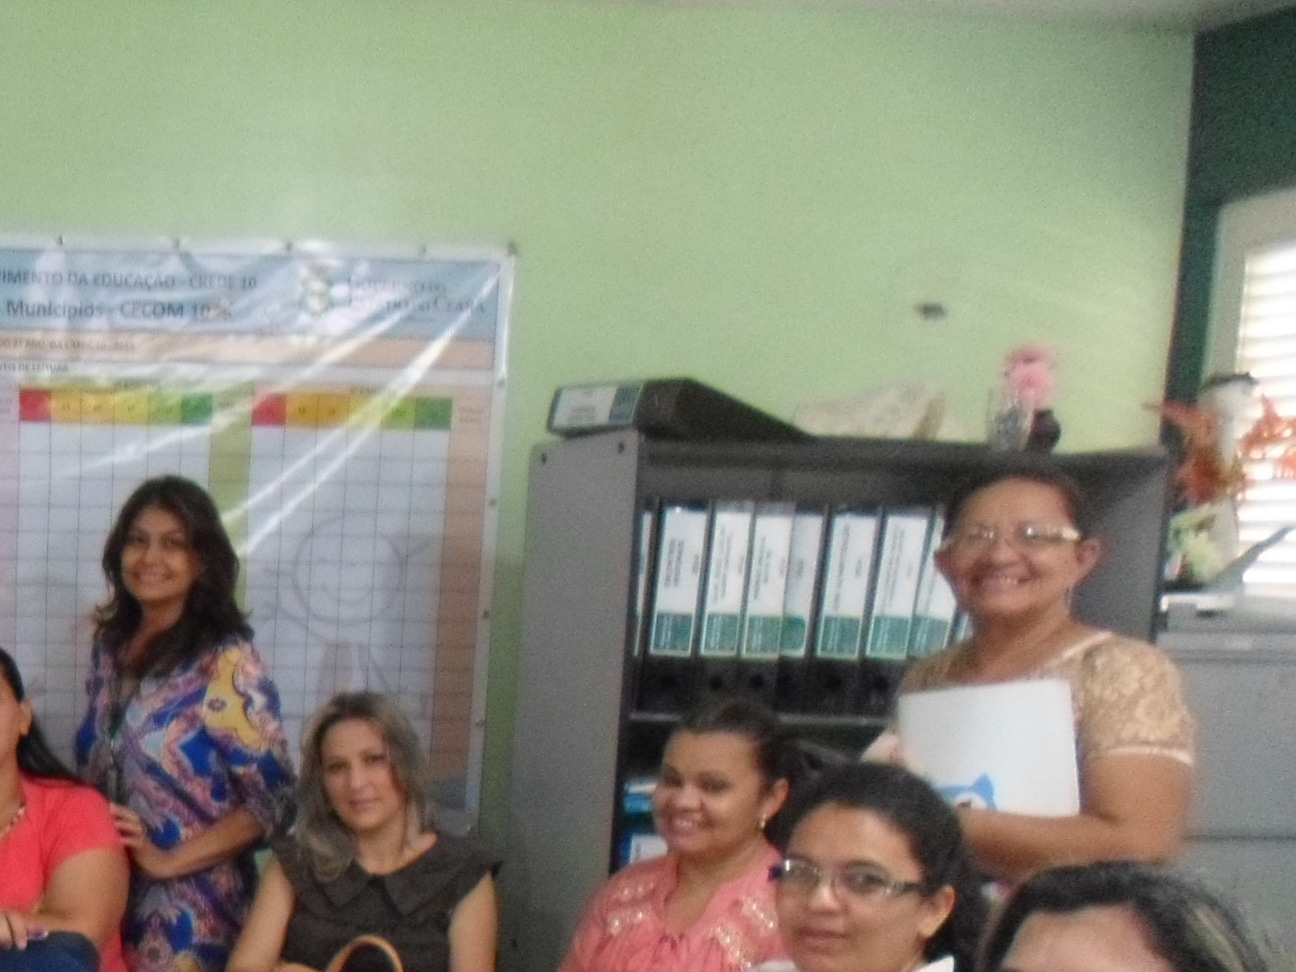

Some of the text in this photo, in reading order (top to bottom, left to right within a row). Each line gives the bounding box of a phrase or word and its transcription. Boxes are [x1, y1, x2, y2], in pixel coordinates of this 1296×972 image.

[68, 272, 88, 287] DA
[93, 270, 176, 291] EDUCAÇÃO
[242, 276, 258, 290] 10
[6, 300, 104, 320] Municípios
[120, 302, 184, 319] CECOM
